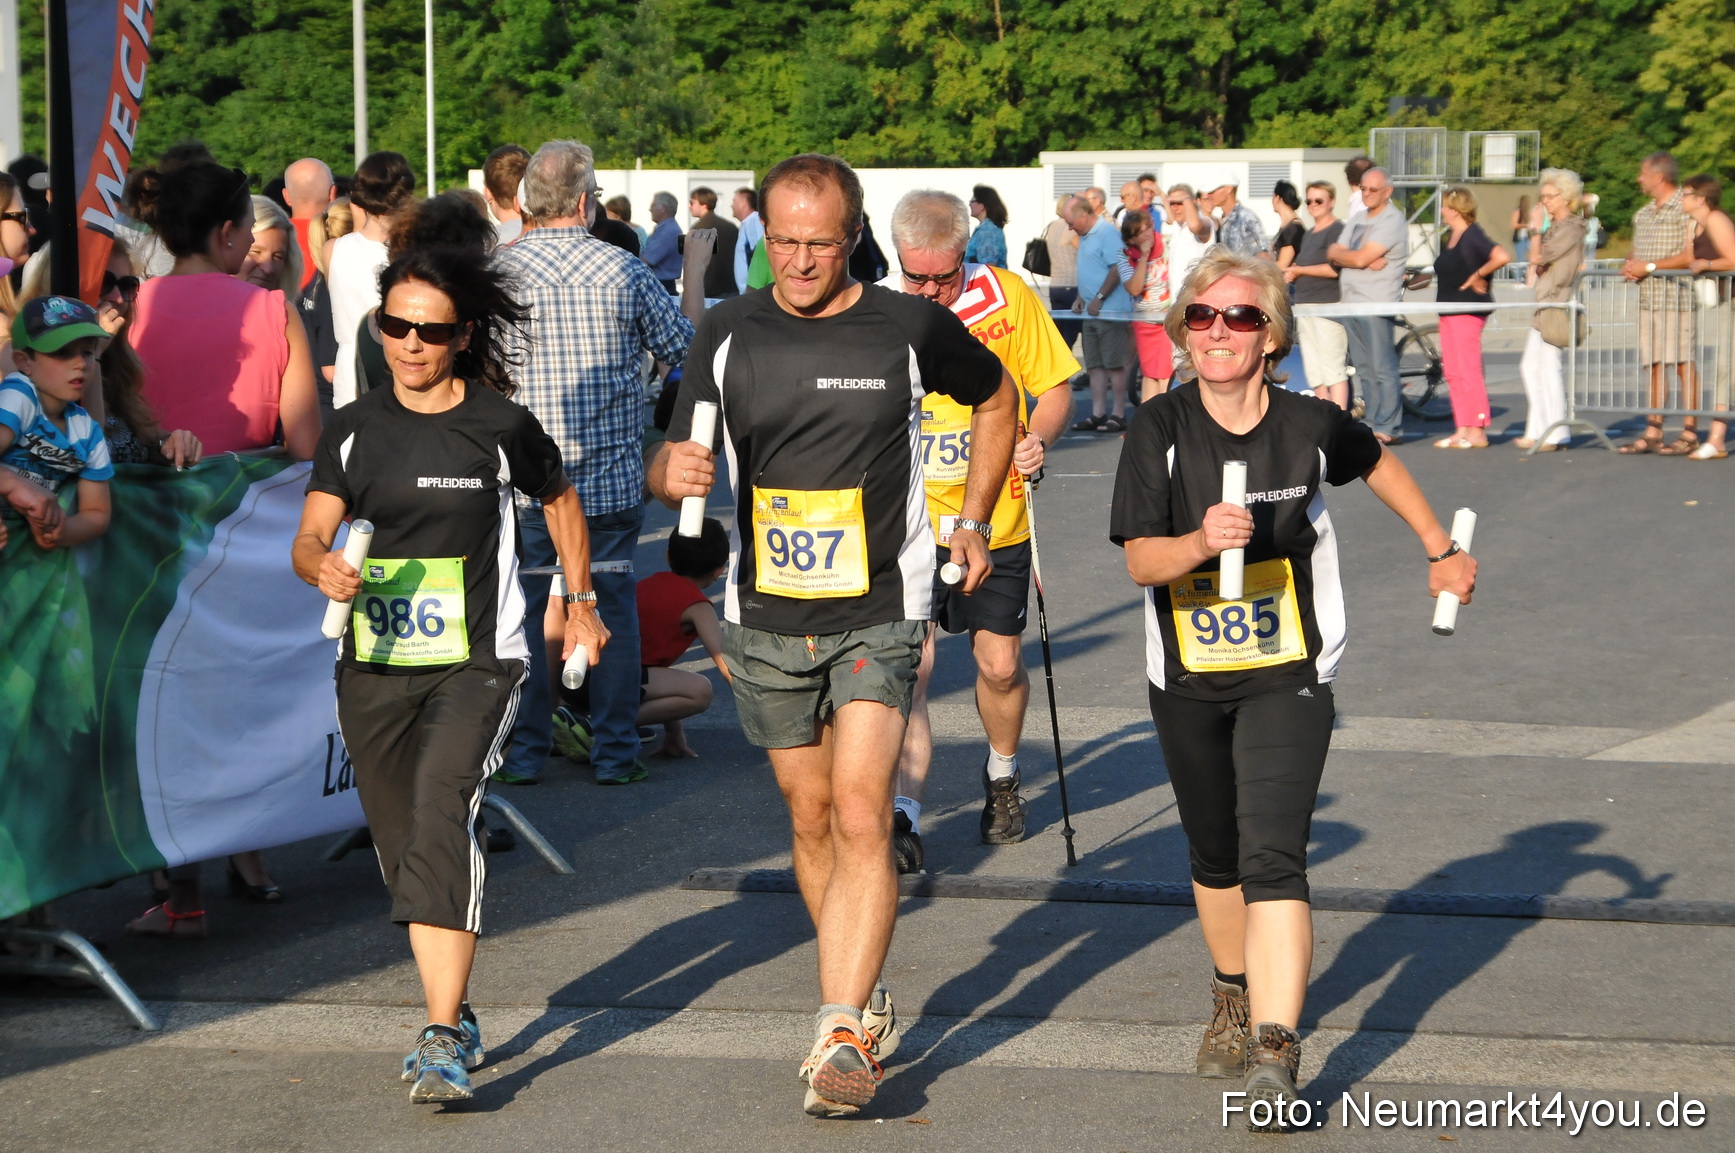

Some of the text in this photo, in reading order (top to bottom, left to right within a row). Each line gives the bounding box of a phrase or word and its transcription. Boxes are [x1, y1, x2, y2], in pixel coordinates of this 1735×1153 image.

[827, 378, 886, 390] PFLEIDERER
[921, 418, 946, 426] menlauf
[427, 477, 483, 489] PFLEIDERER
[1252, 485, 1308, 503] PFLEIDERER
[766, 527, 845, 572] 987
[365, 596, 445, 640] 986
[1190, 596, 1280, 645] 985
